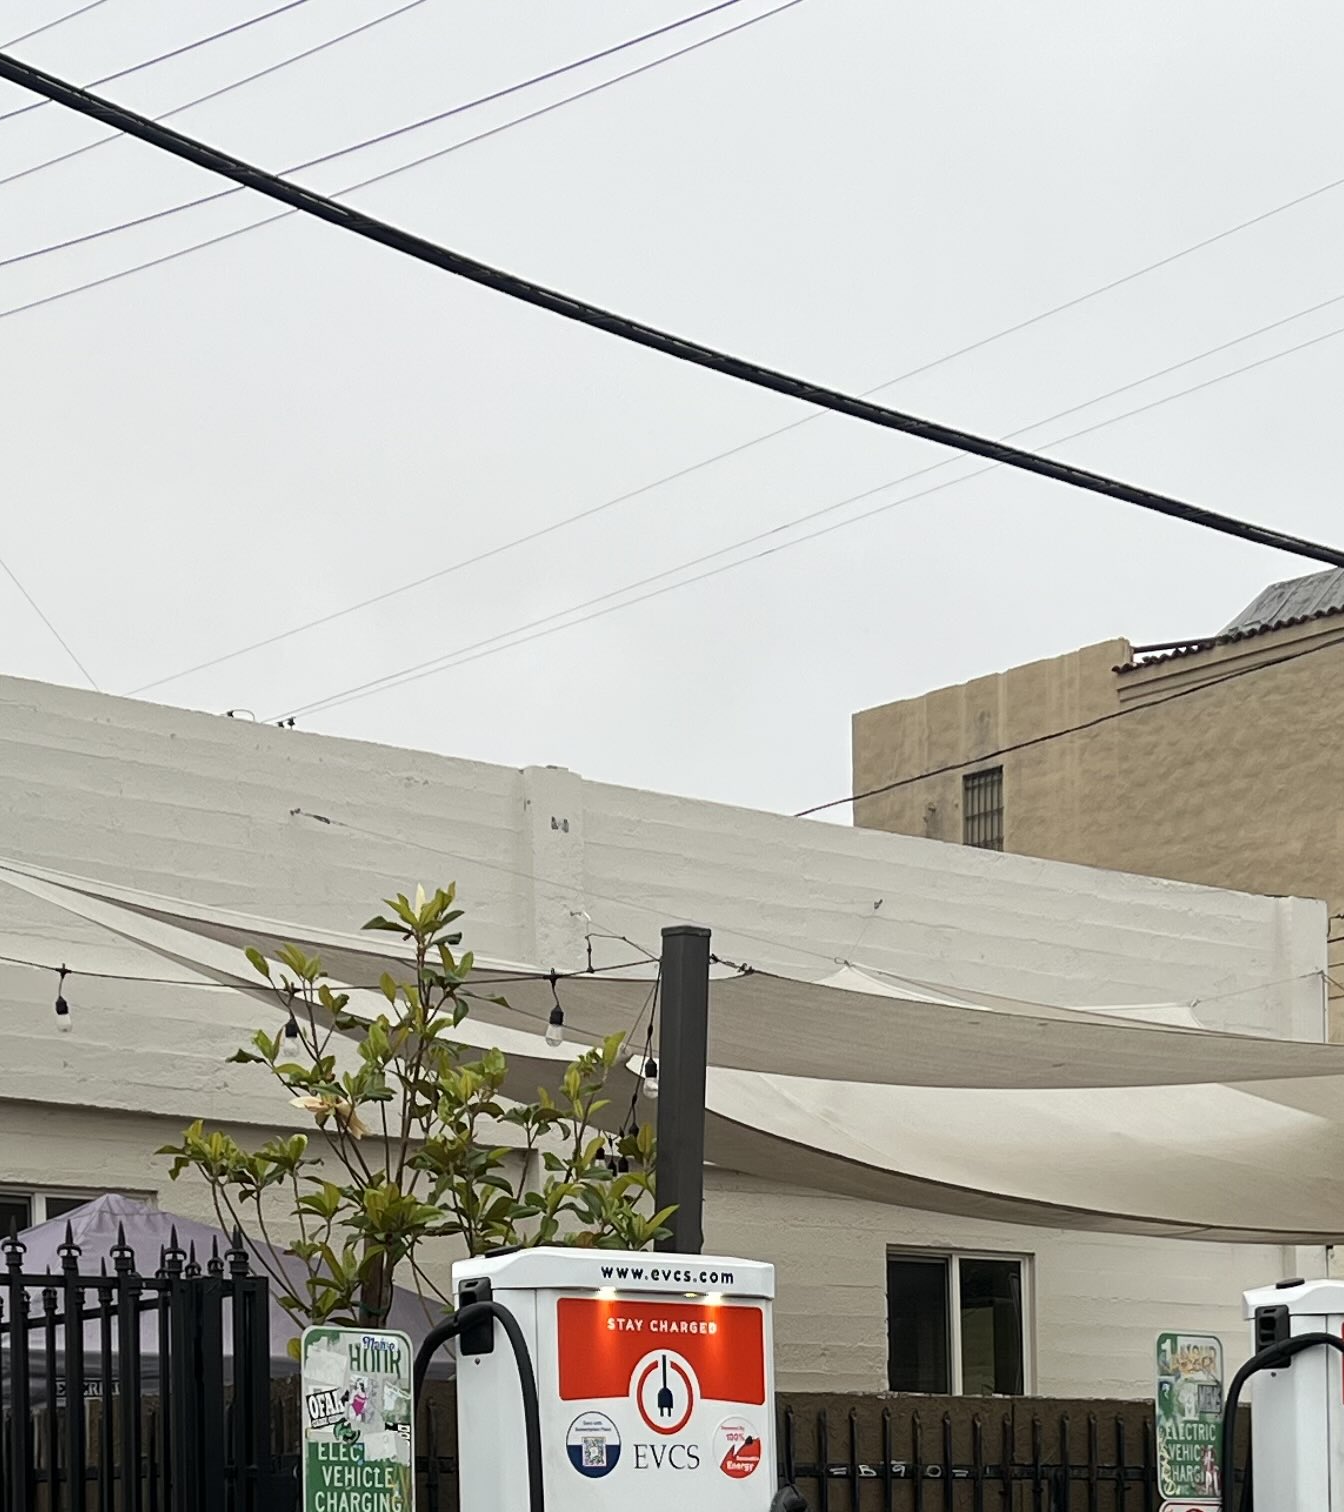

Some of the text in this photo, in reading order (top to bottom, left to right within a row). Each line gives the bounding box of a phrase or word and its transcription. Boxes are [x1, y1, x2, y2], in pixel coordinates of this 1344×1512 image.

[600, 1266, 735, 1285] www.evcs.com
[607, 1318, 717, 1335] STAY CHARGED
[633, 1444, 700, 1470] EVCS
[322, 1466, 394, 1488] VEHICLE
